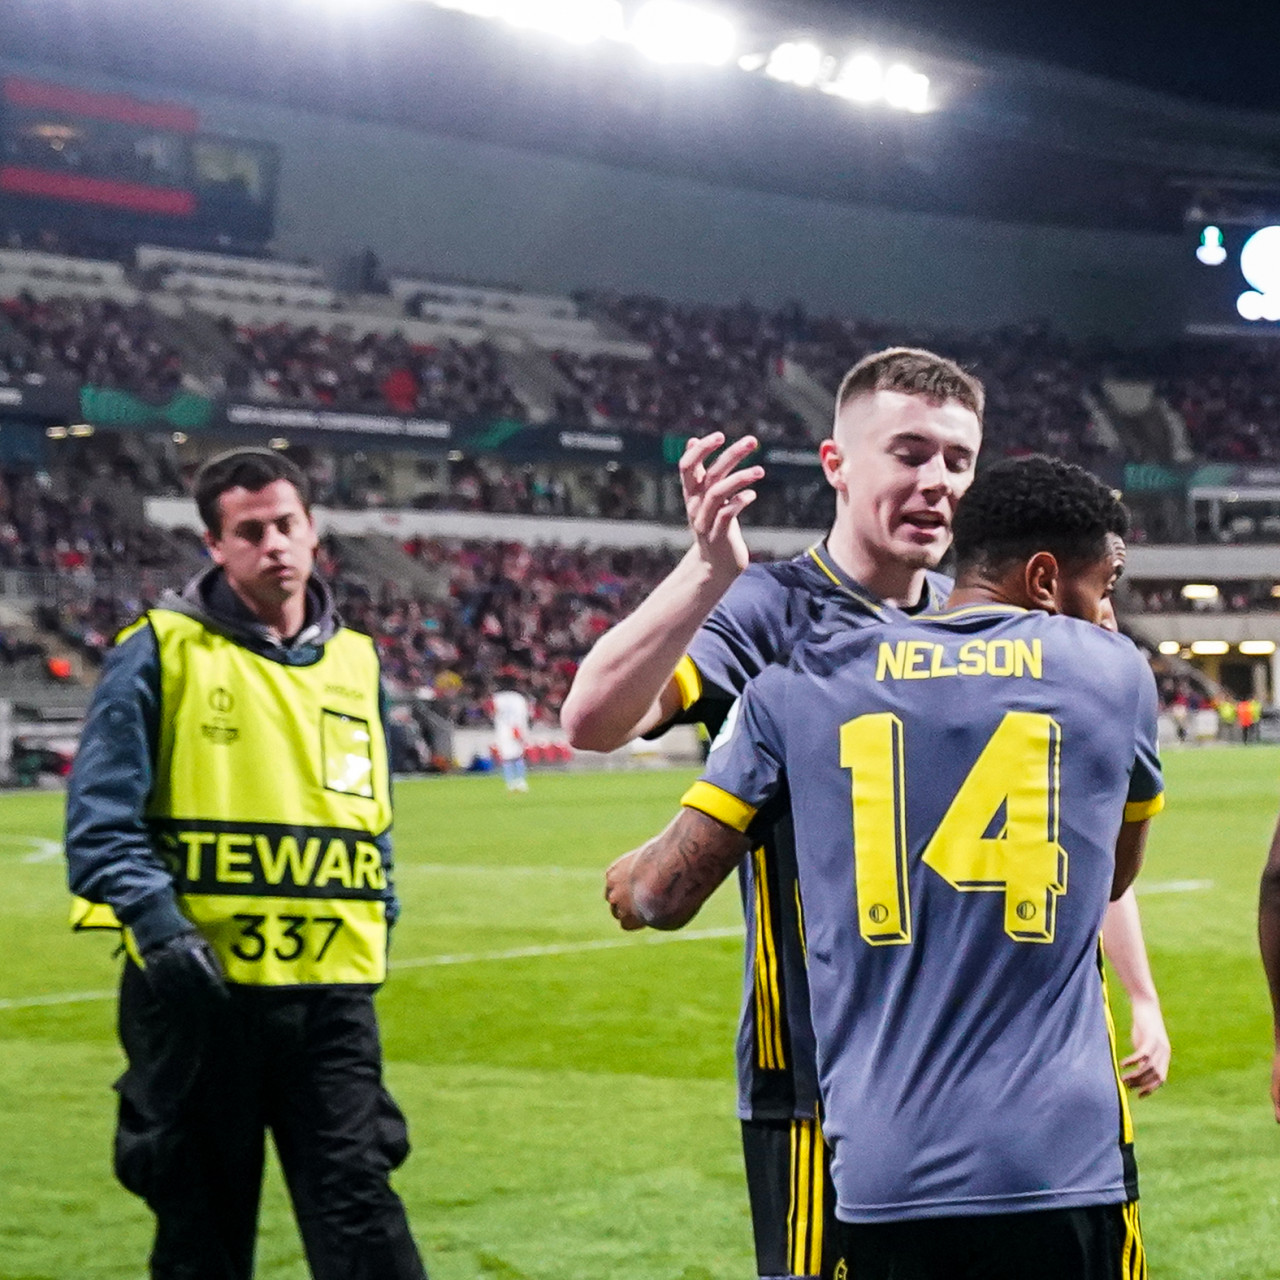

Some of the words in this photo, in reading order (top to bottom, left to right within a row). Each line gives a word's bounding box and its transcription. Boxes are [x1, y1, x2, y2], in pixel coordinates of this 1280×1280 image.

[875, 638, 1043, 681] NELSON
[839, 711, 1068, 946] 14
[230, 913, 344, 963] 337
